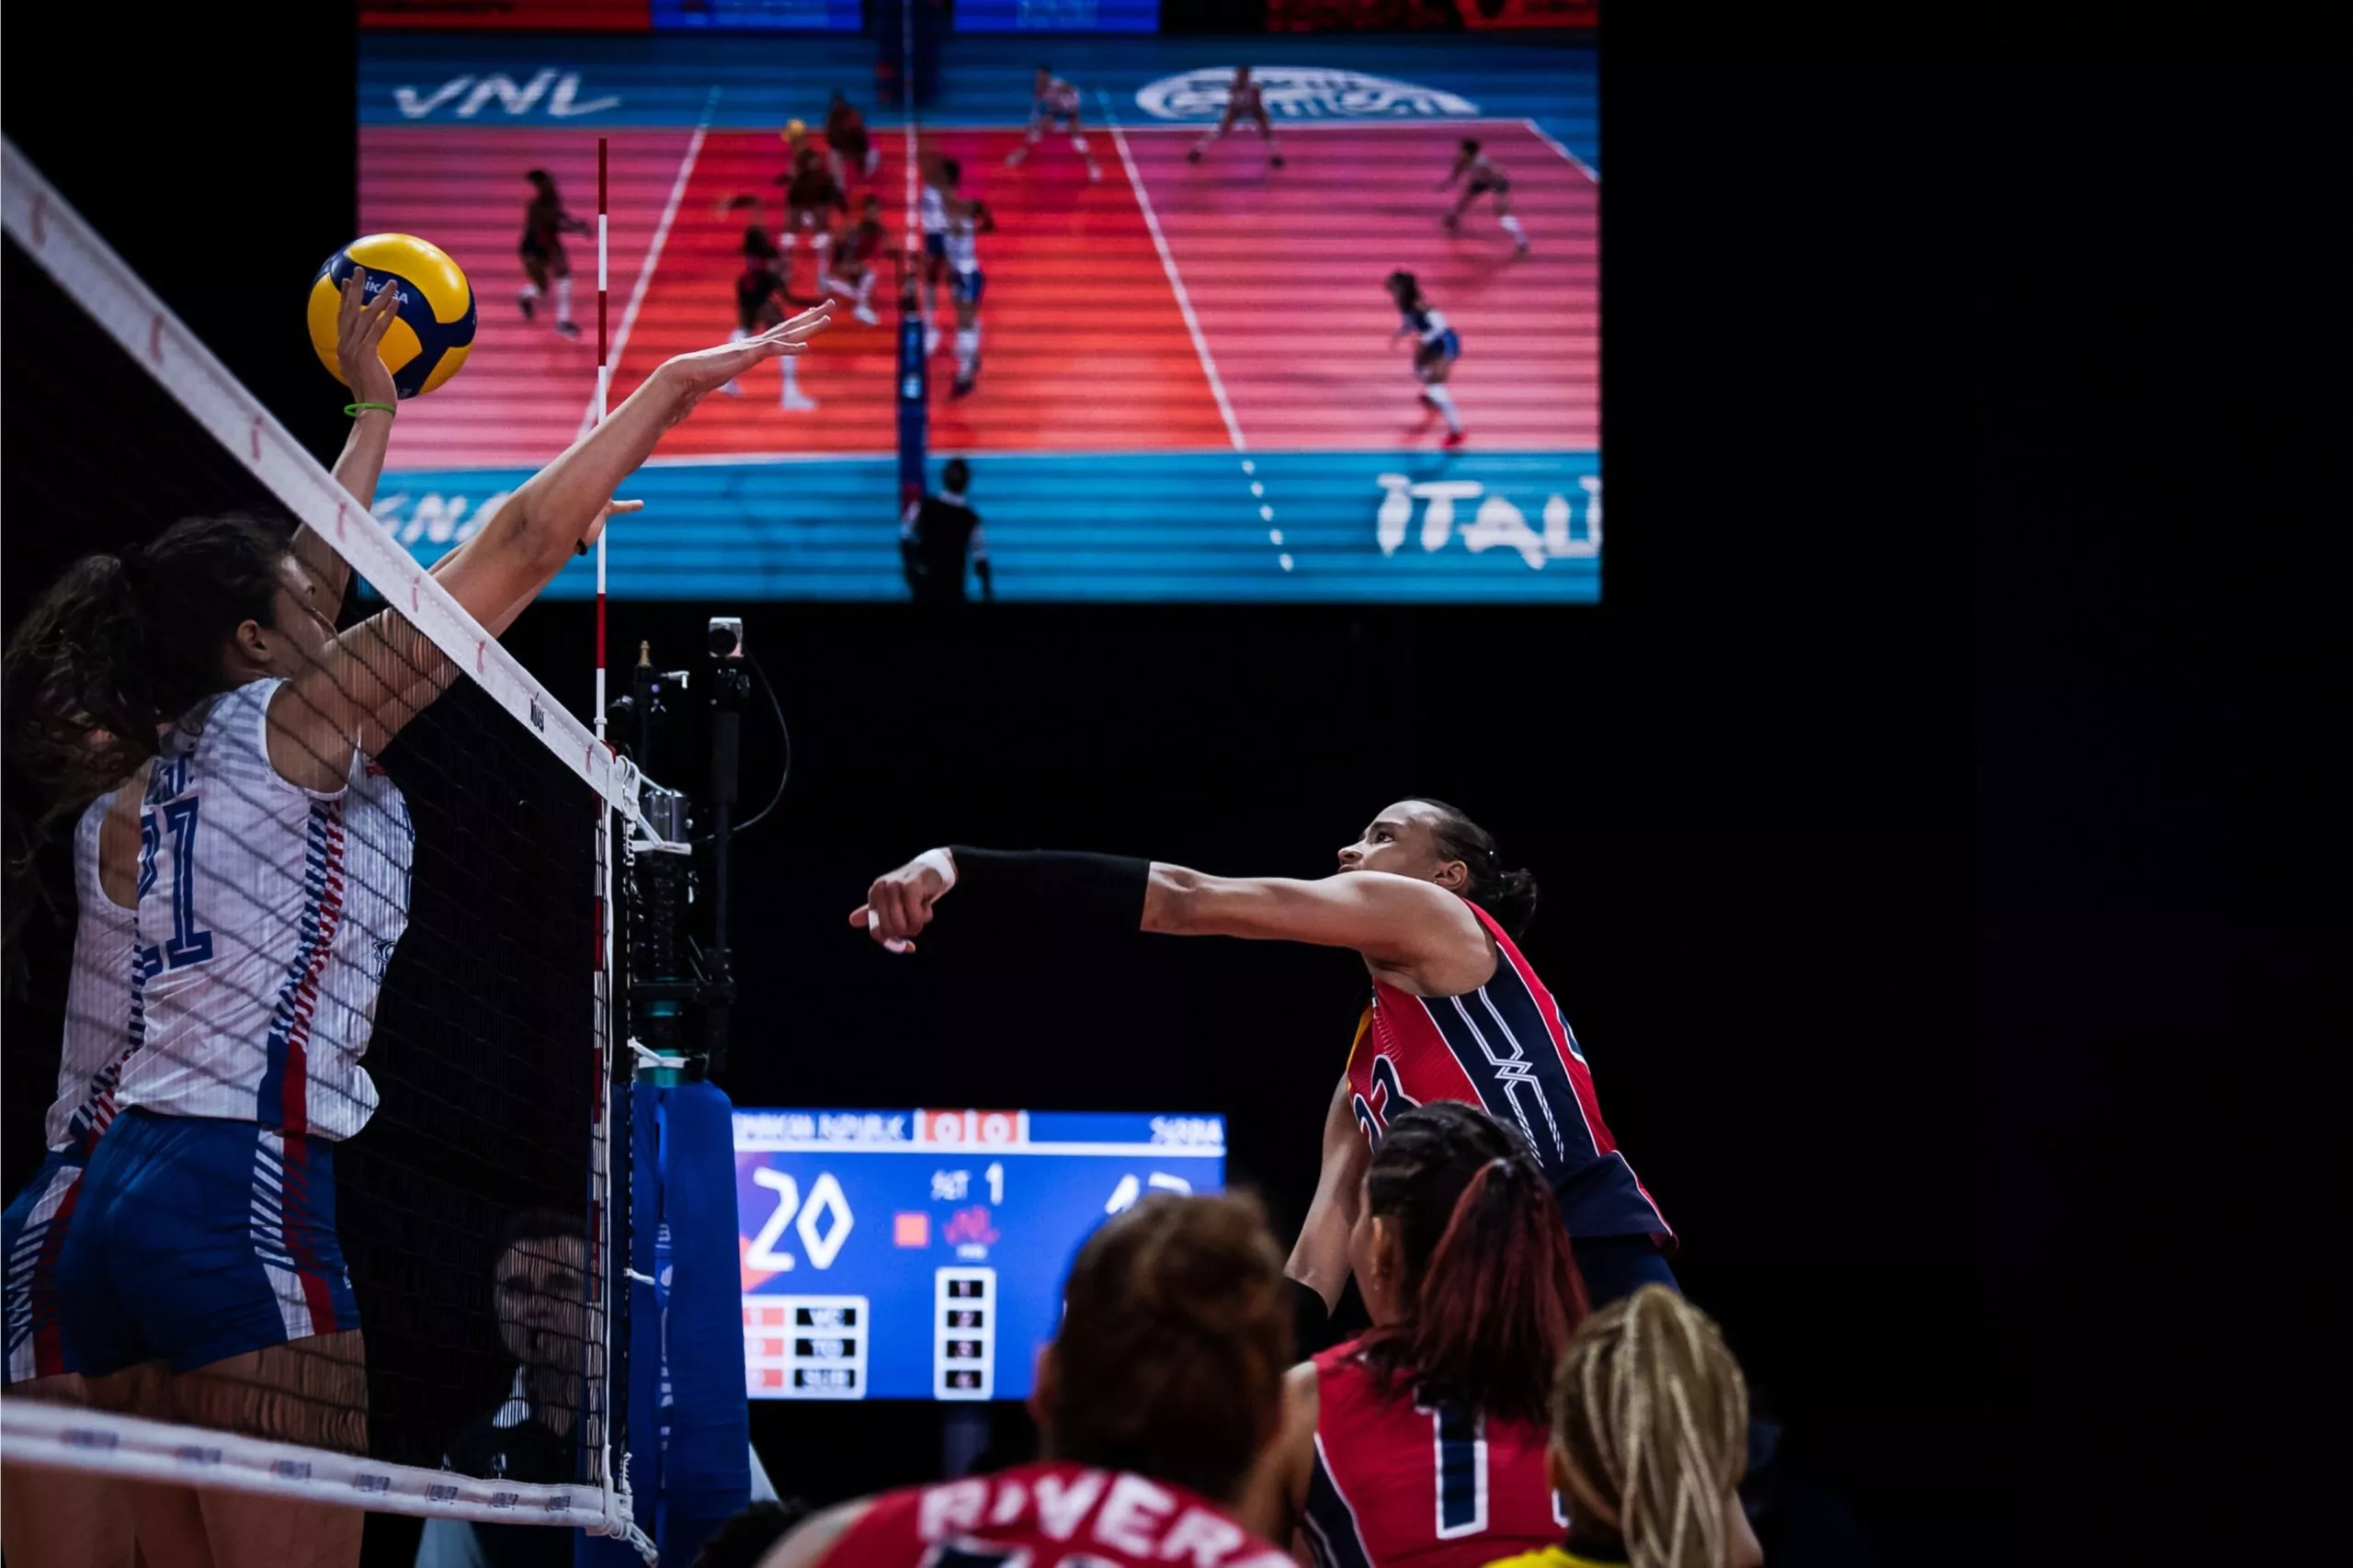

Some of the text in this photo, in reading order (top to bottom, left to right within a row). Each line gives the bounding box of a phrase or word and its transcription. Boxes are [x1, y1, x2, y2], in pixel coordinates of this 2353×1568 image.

[393, 68, 620, 119] VNL
[984, 1161, 1004, 1206] 1
[745, 1166, 855, 1271] 20
